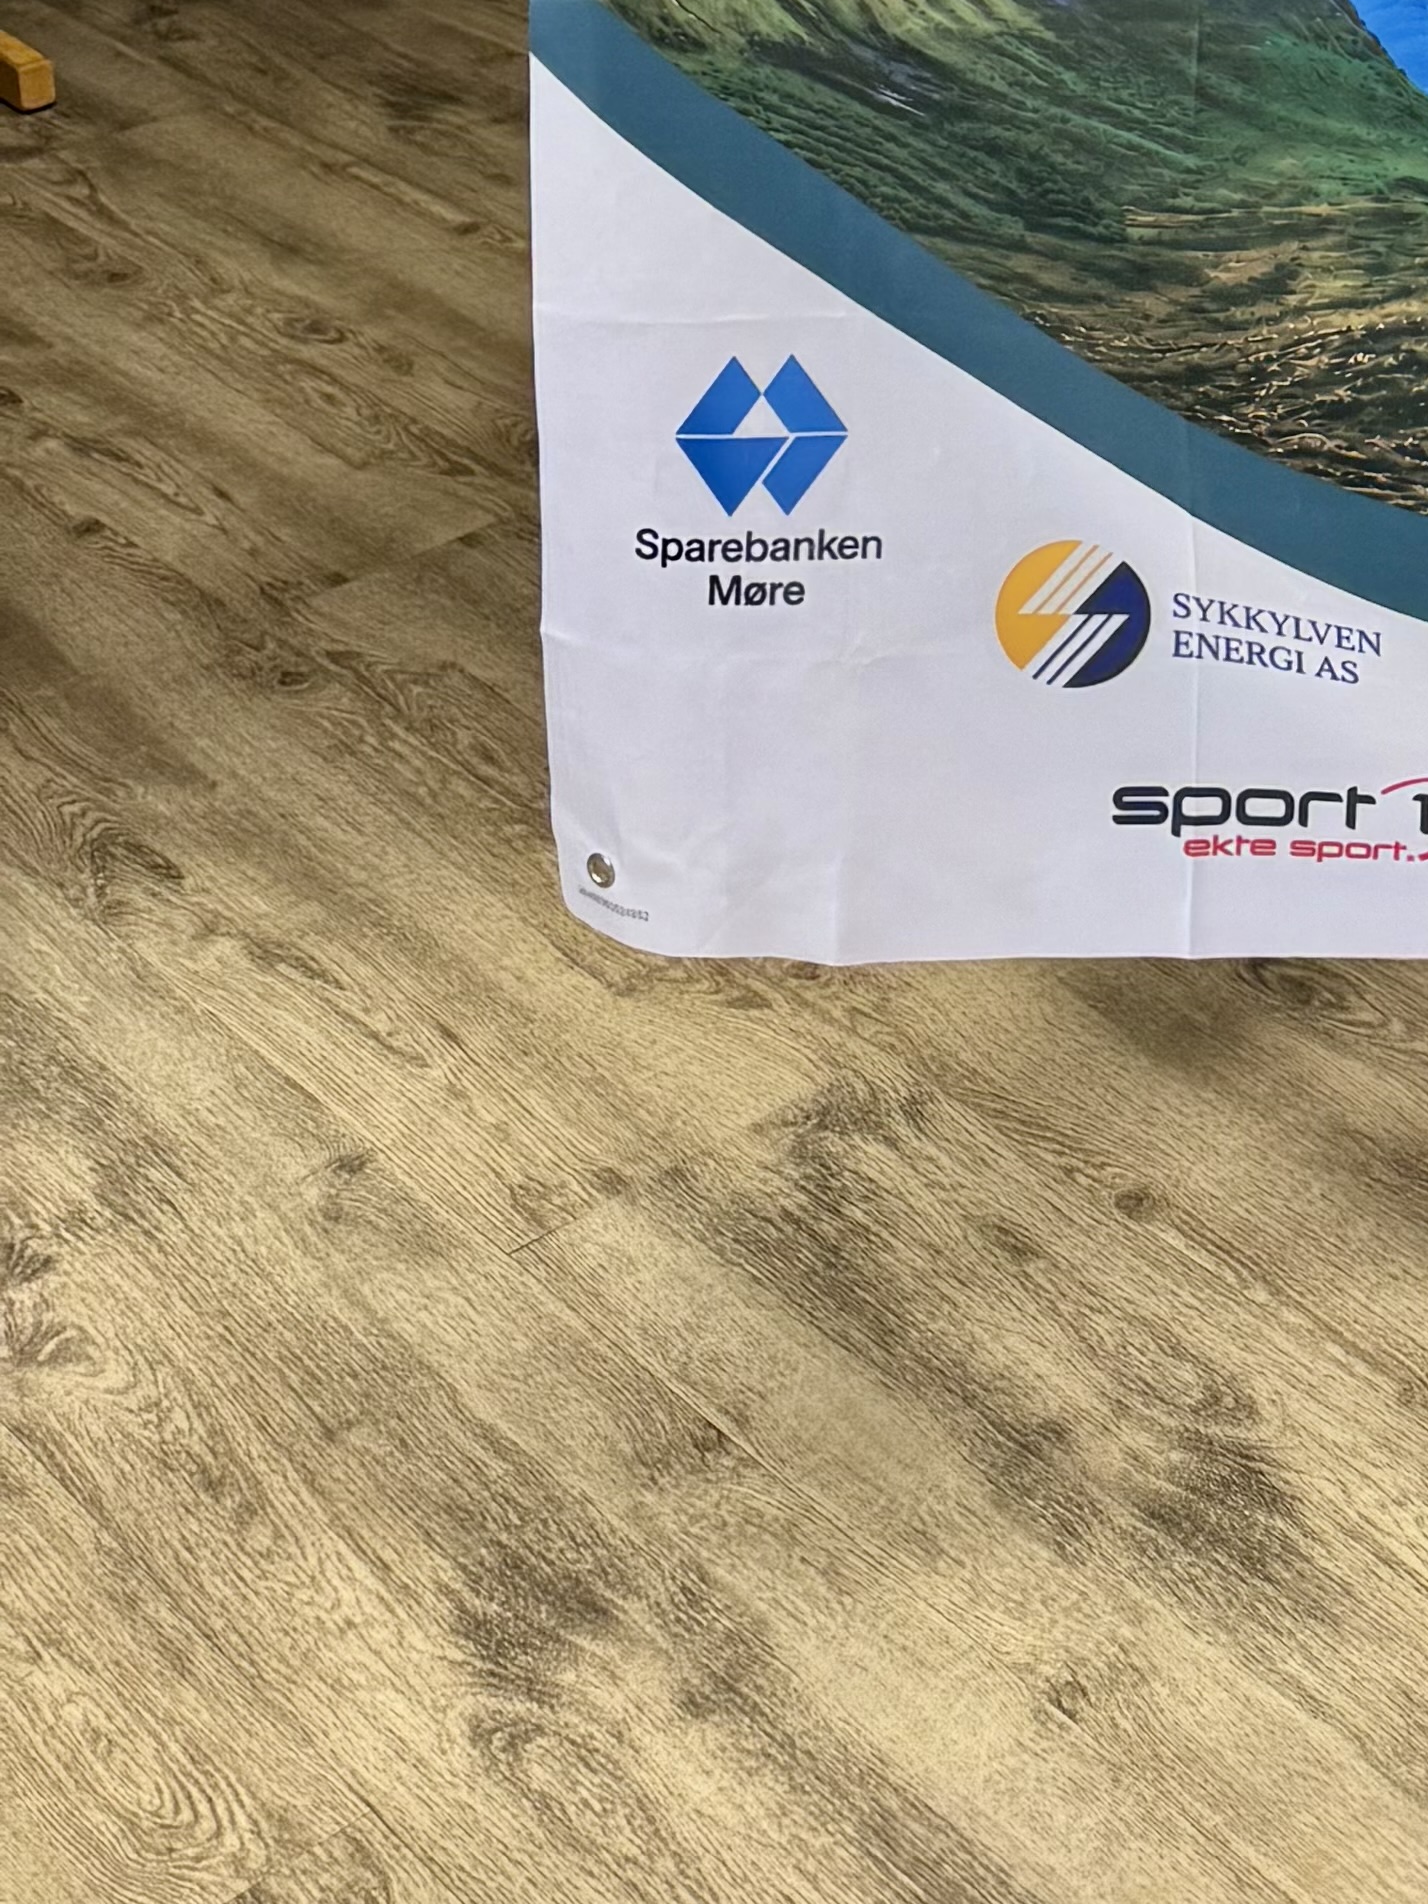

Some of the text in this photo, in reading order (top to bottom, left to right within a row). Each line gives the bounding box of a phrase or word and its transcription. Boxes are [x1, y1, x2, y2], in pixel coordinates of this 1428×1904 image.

[633, 528, 882, 566] Sparebanken
[708, 575, 805, 608] Møre
[1171, 592, 1383, 658] SYKKYLVEN
[1171, 629, 1360, 685] ENERGI AS
[1112, 785, 1376, 837] sport
[1182, 835, 1277, 858] ekte
